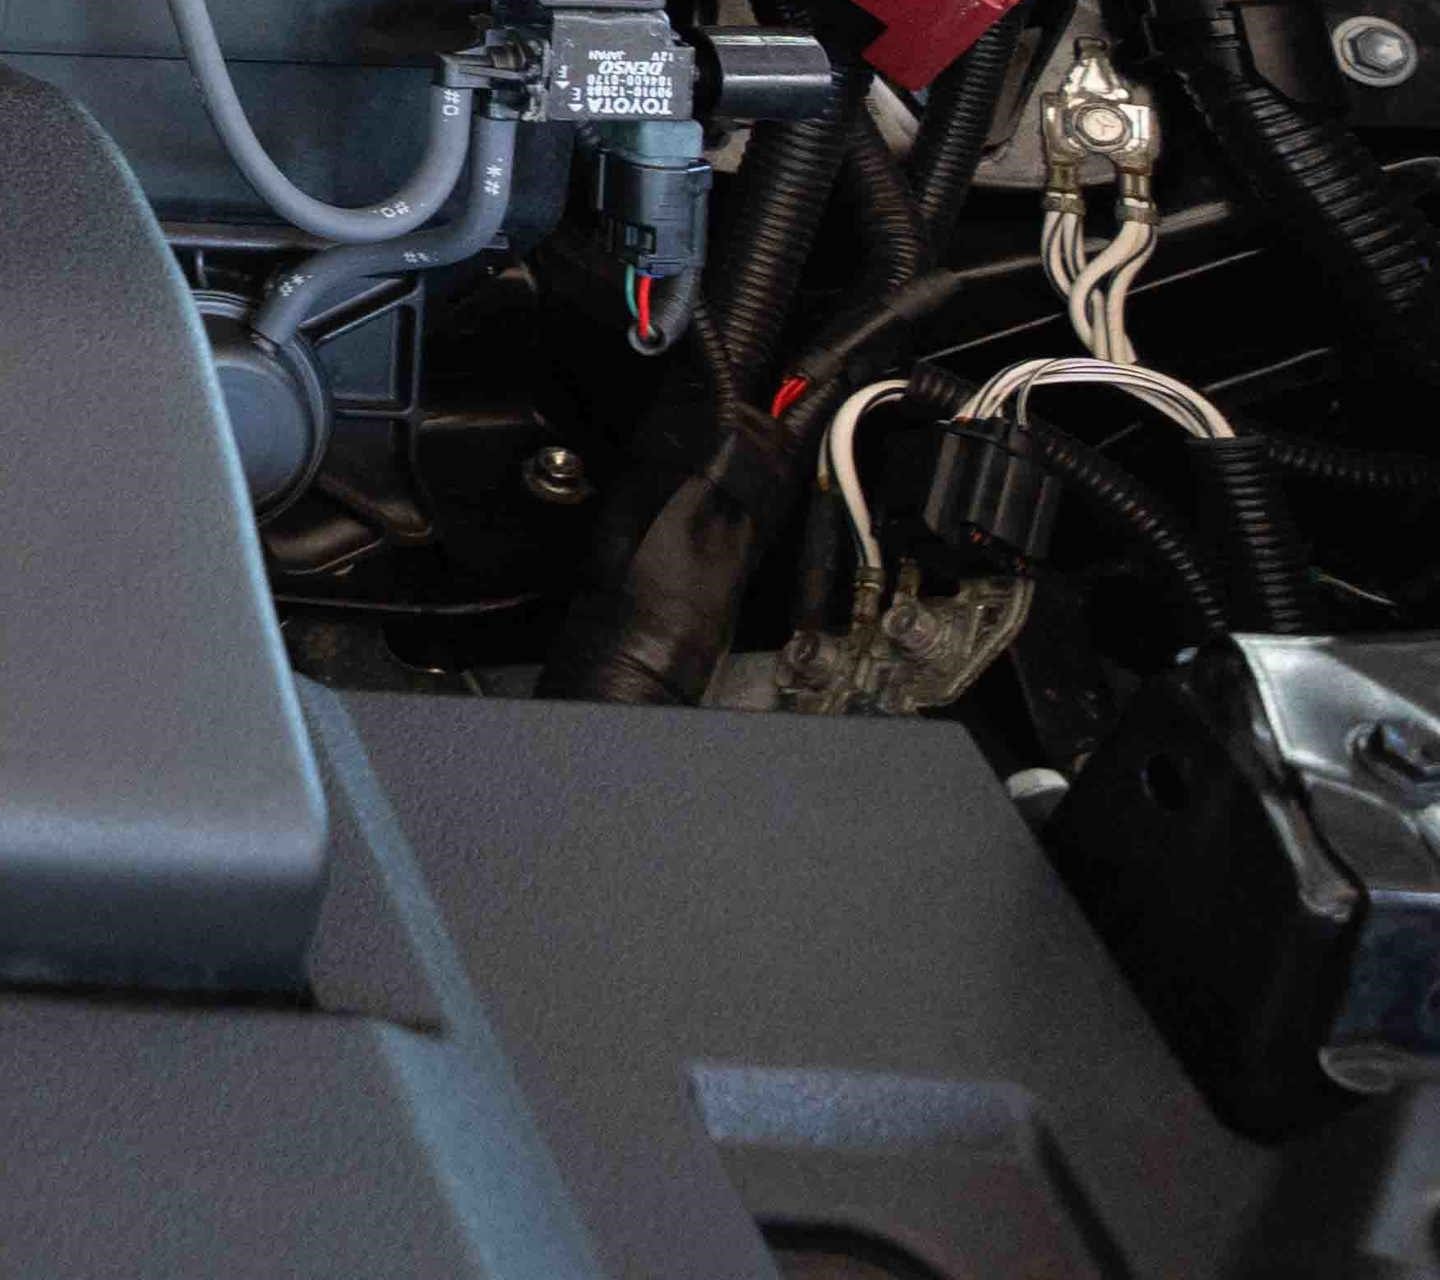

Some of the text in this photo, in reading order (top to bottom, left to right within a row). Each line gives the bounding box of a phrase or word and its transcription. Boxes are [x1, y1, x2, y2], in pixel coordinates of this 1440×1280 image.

[587, 49, 627, 60] JAPAN
[598, 59, 665, 76] DENSO
[586, 97, 674, 116] TOYOTA
